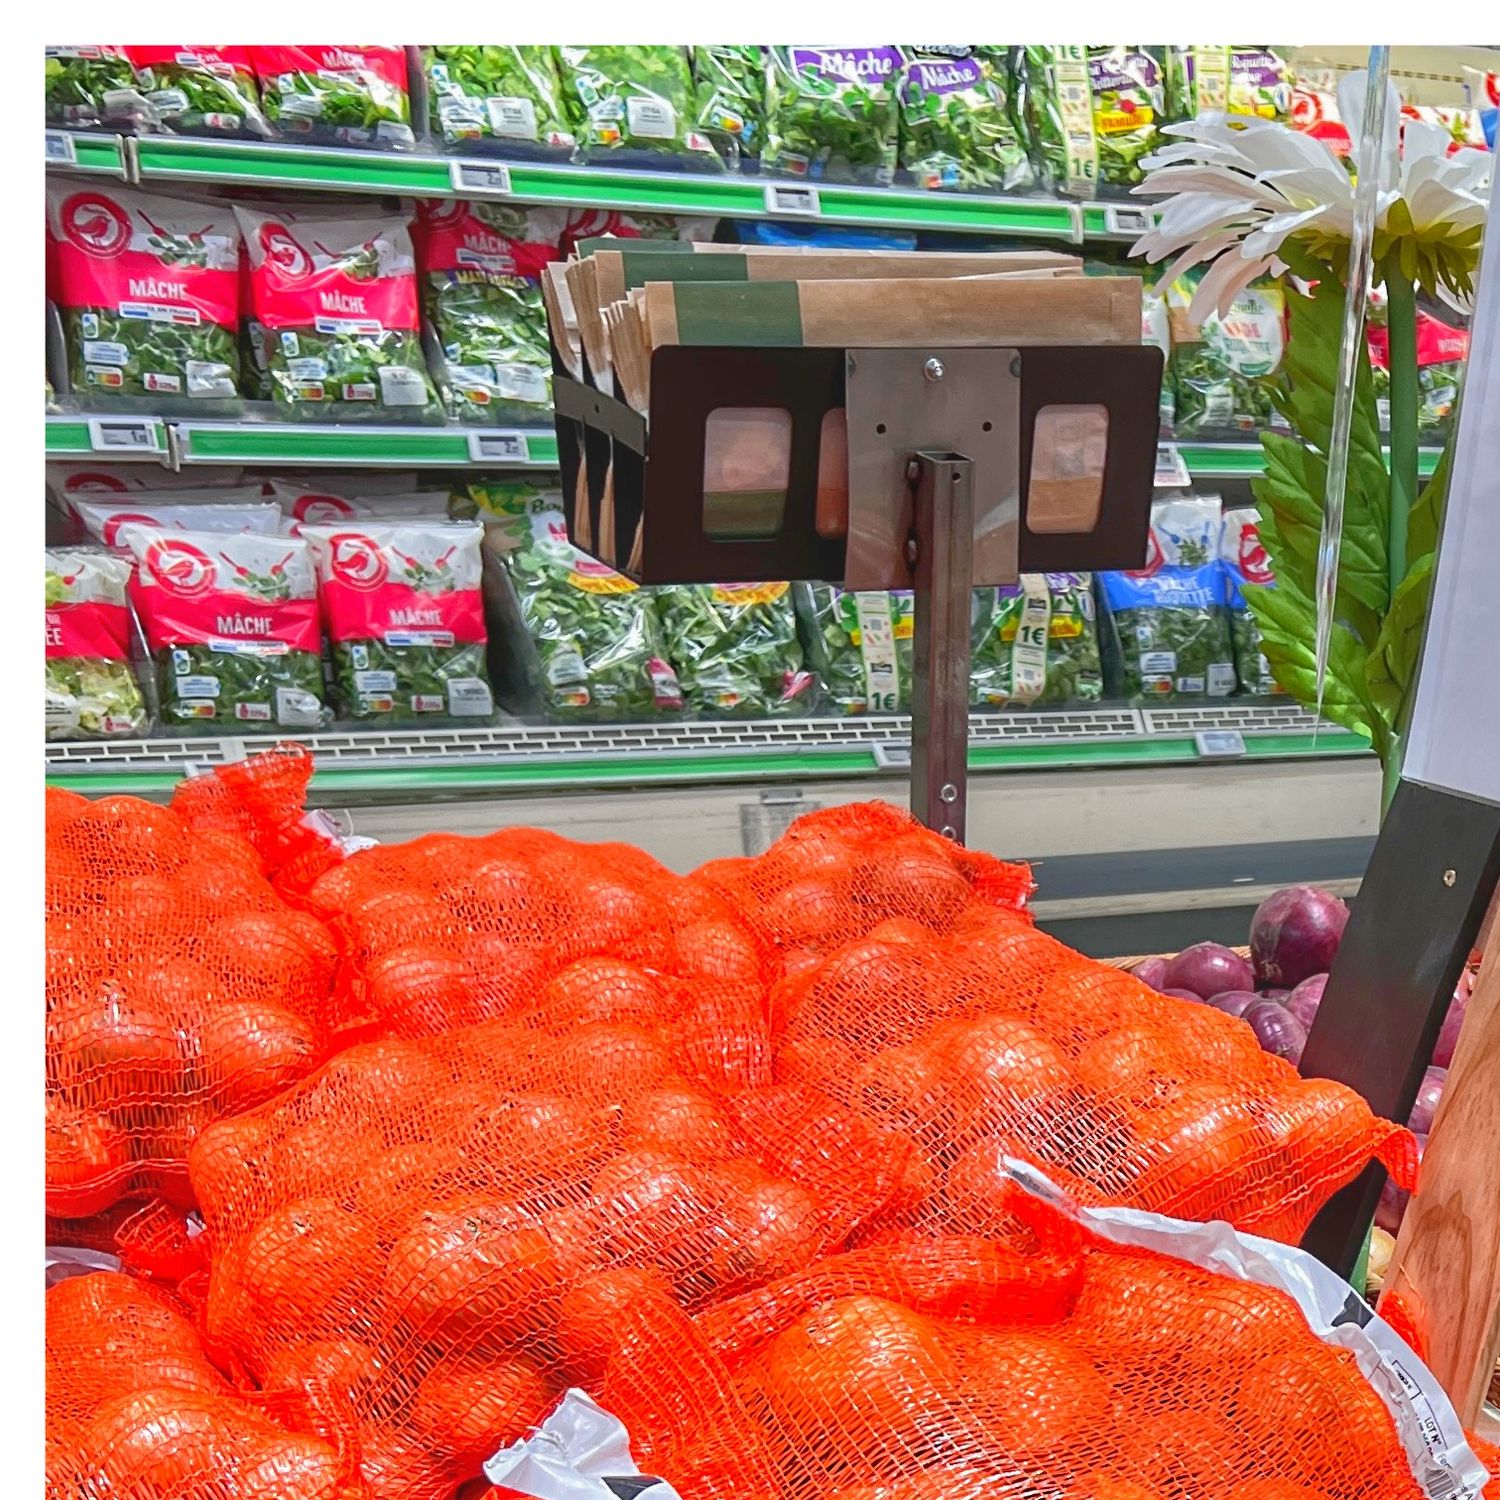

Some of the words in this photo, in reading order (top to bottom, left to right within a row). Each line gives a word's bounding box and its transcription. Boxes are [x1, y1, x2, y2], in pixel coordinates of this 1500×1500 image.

[820, 53, 893, 75] Mâche
[129, 279, 187, 300] MÂCHE
[321, 291, 367, 315] MÂCHE
[217, 614, 273, 636] MÂCHE
[388, 607, 444, 629] MÂCHE
[1021, 626, 1045, 645] 1€
[873, 693, 895, 711] 1€
